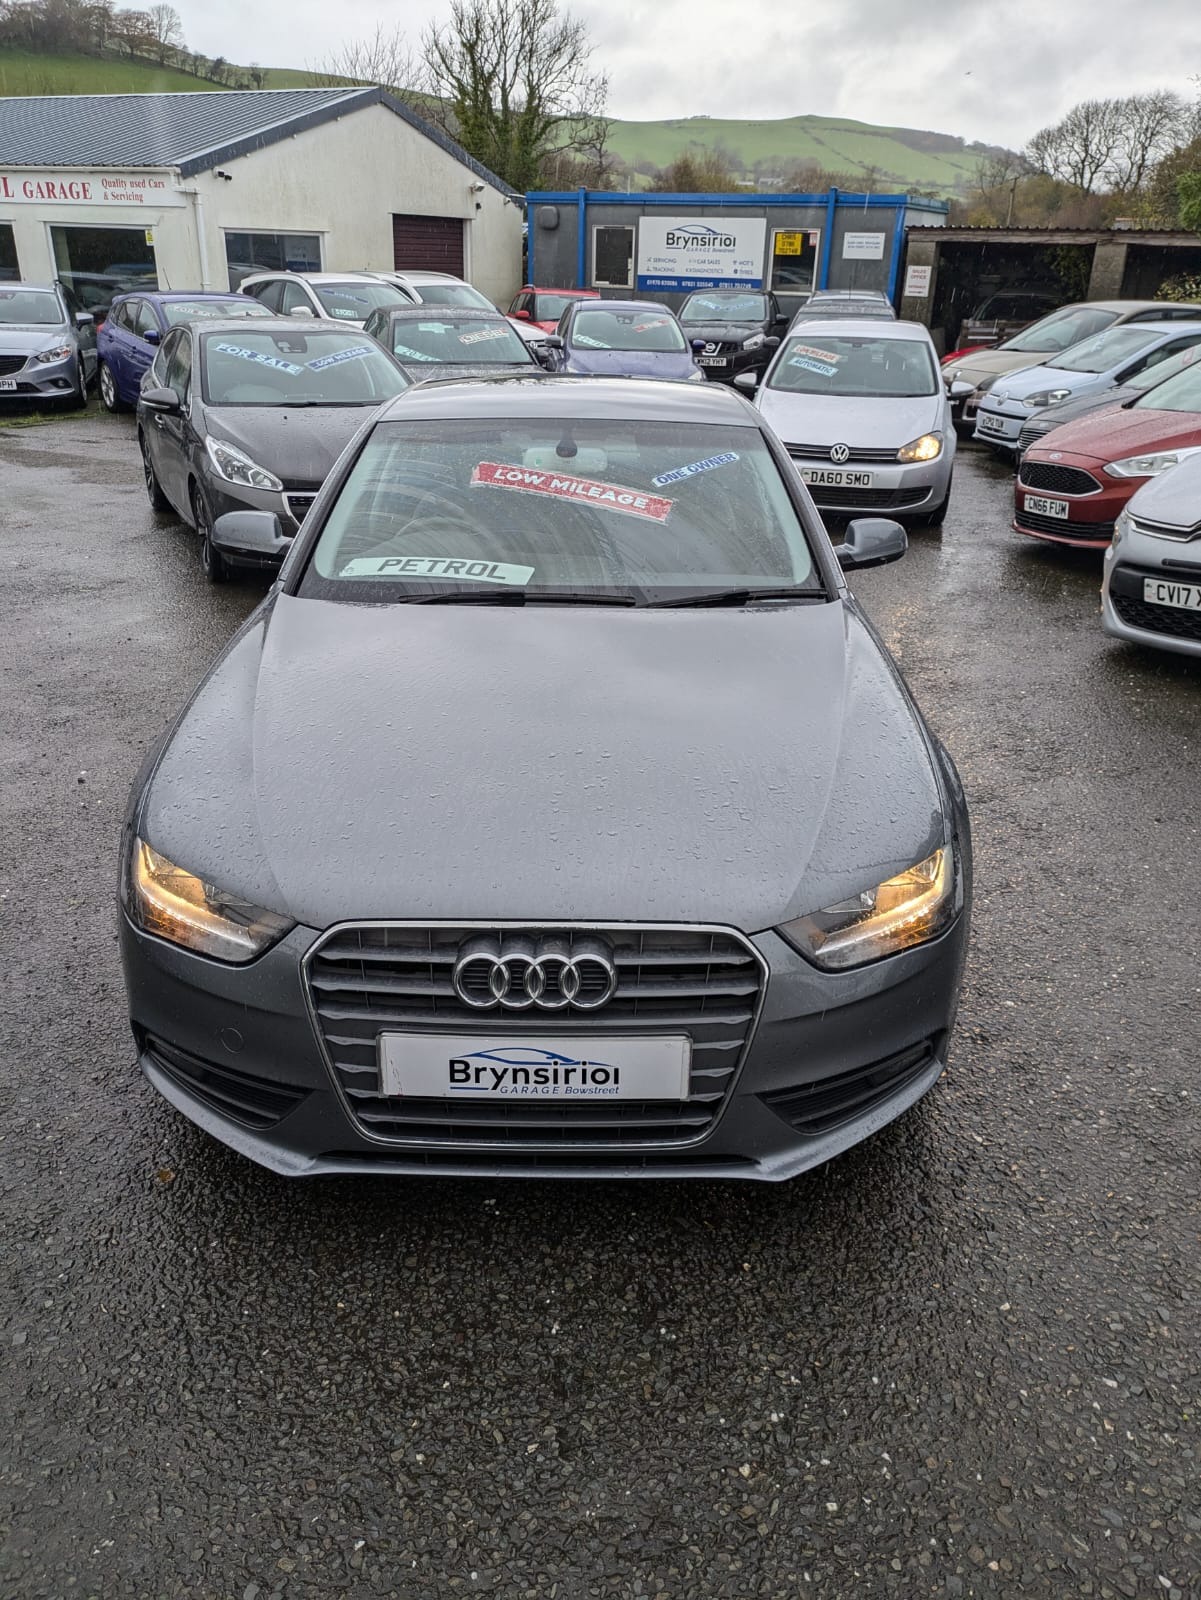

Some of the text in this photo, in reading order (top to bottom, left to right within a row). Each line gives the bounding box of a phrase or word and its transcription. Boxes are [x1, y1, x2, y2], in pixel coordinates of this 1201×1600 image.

[0, 177, 93, 200] L GARAGE
[102, 178, 165, 190] Quality used Cars
[104, 191, 144, 204] & Servicing
[666, 232, 737, 250] Brynsiriol
[216, 343, 300, 375] FOR SALE
[794, 358, 833, 374] AUTOMATIC
[0, 380, 13, 389] PH
[656, 453, 737, 484] ONE OWNER
[811, 471, 870, 486] DA60 SMO
[494, 468, 649, 509] LOW MILEAGE
[1029, 497, 1048, 512] CN66
[377, 559, 506, 580] PETROL
[1157, 584, 1191, 605] CV17
[449, 1059, 620, 1091] Brynsiriol
[500, 1085, 620, 1096] GARAGE Bowstreet
